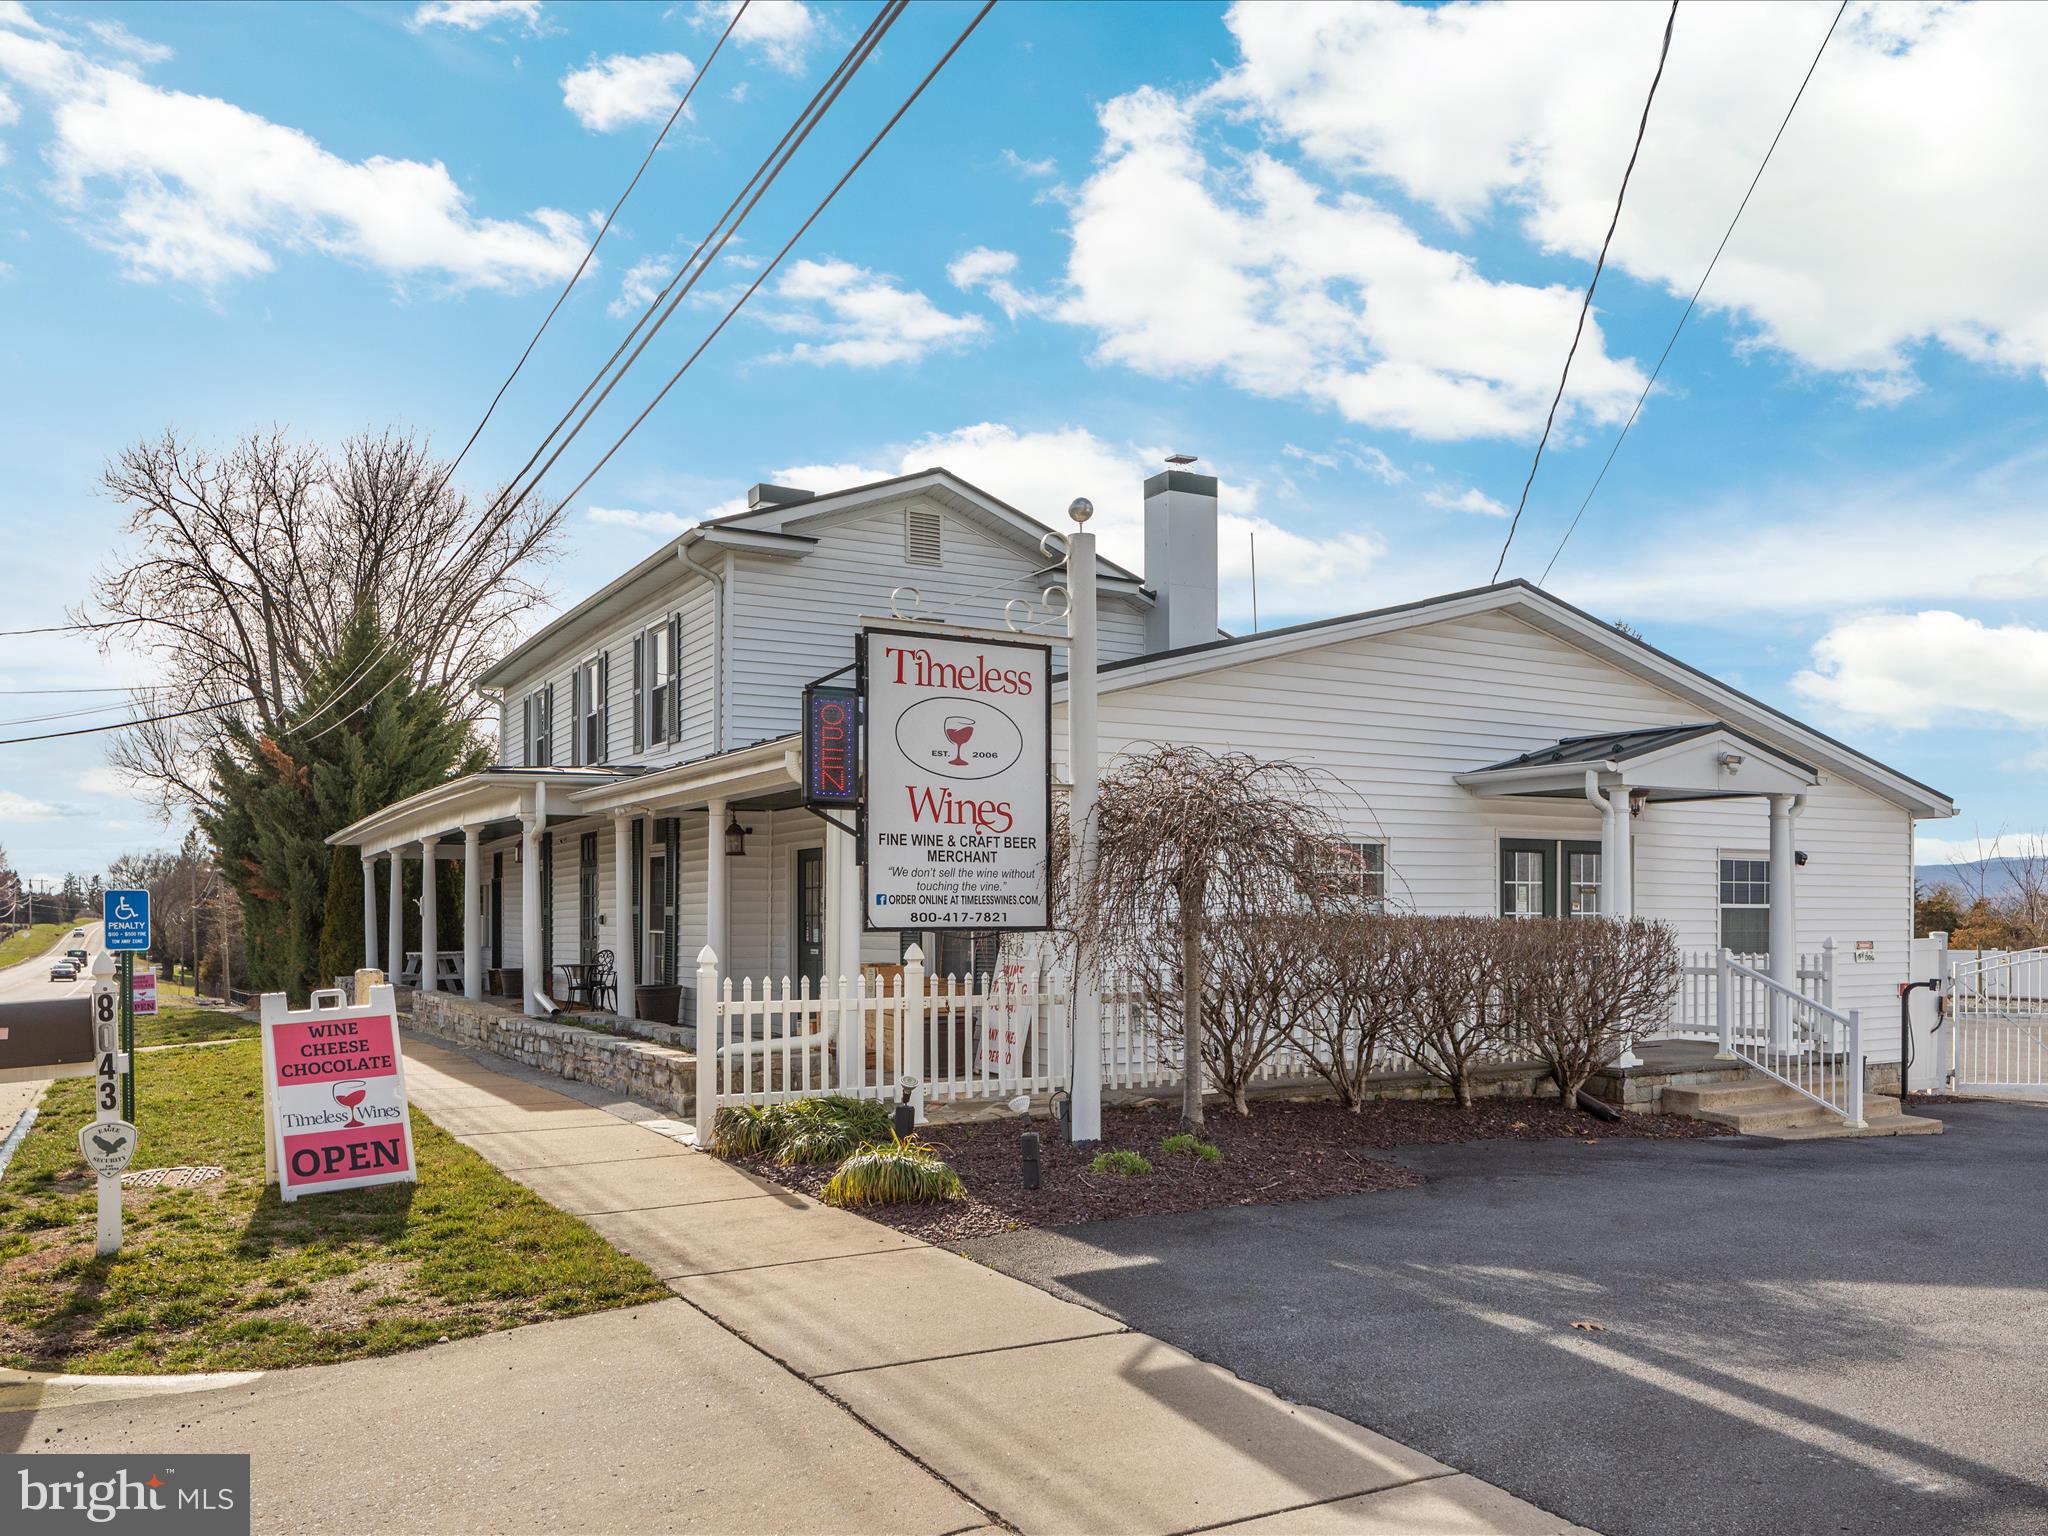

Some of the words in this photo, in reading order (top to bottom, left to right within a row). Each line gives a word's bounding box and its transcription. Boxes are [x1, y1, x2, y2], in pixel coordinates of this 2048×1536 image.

[885, 647, 1033, 696] Timeless
[820, 703, 846, 791] OPEN
[931, 750, 950, 758] EST.
[972, 751, 998, 759] 2006
[905, 785, 1014, 835] Wines
[878, 833, 908, 846] FINE
[910, 834, 944, 847] WINE
[947, 834, 956, 847] &
[959, 835, 1001, 849] CRAFT
[1003, 836, 1037, 849] BEER
[927, 849, 998, 863] MERCHANT
[938, 867, 956, 878] sell
[958, 868, 974, 878] the
[976, 868, 999, 878] wine
[1001, 868, 1035, 879] without
[916, 881, 959, 894] touching
[961, 881, 977, 891] the
[888, 894, 917, 905] ORDER
[918, 894, 948, 905] ONLINE
[949, 895, 959, 905] AT
[960, 895, 1039, 905] TIMELESSWINES.COM
[910, 912, 1007, 922] 800-417-7821
[108, 921, 146, 930] PENALTY
[308, 1022, 359, 1038] WINE
[97, 994, 117, 1111] 8043
[300, 1039, 370, 1058] CHEESE
[281, 1055, 392, 1078] CHOCOLATE
[283, 1109, 349, 1128] Timeless
[357, 1105, 401, 1120] Wines
[291, 1138, 400, 1178] OPEN
